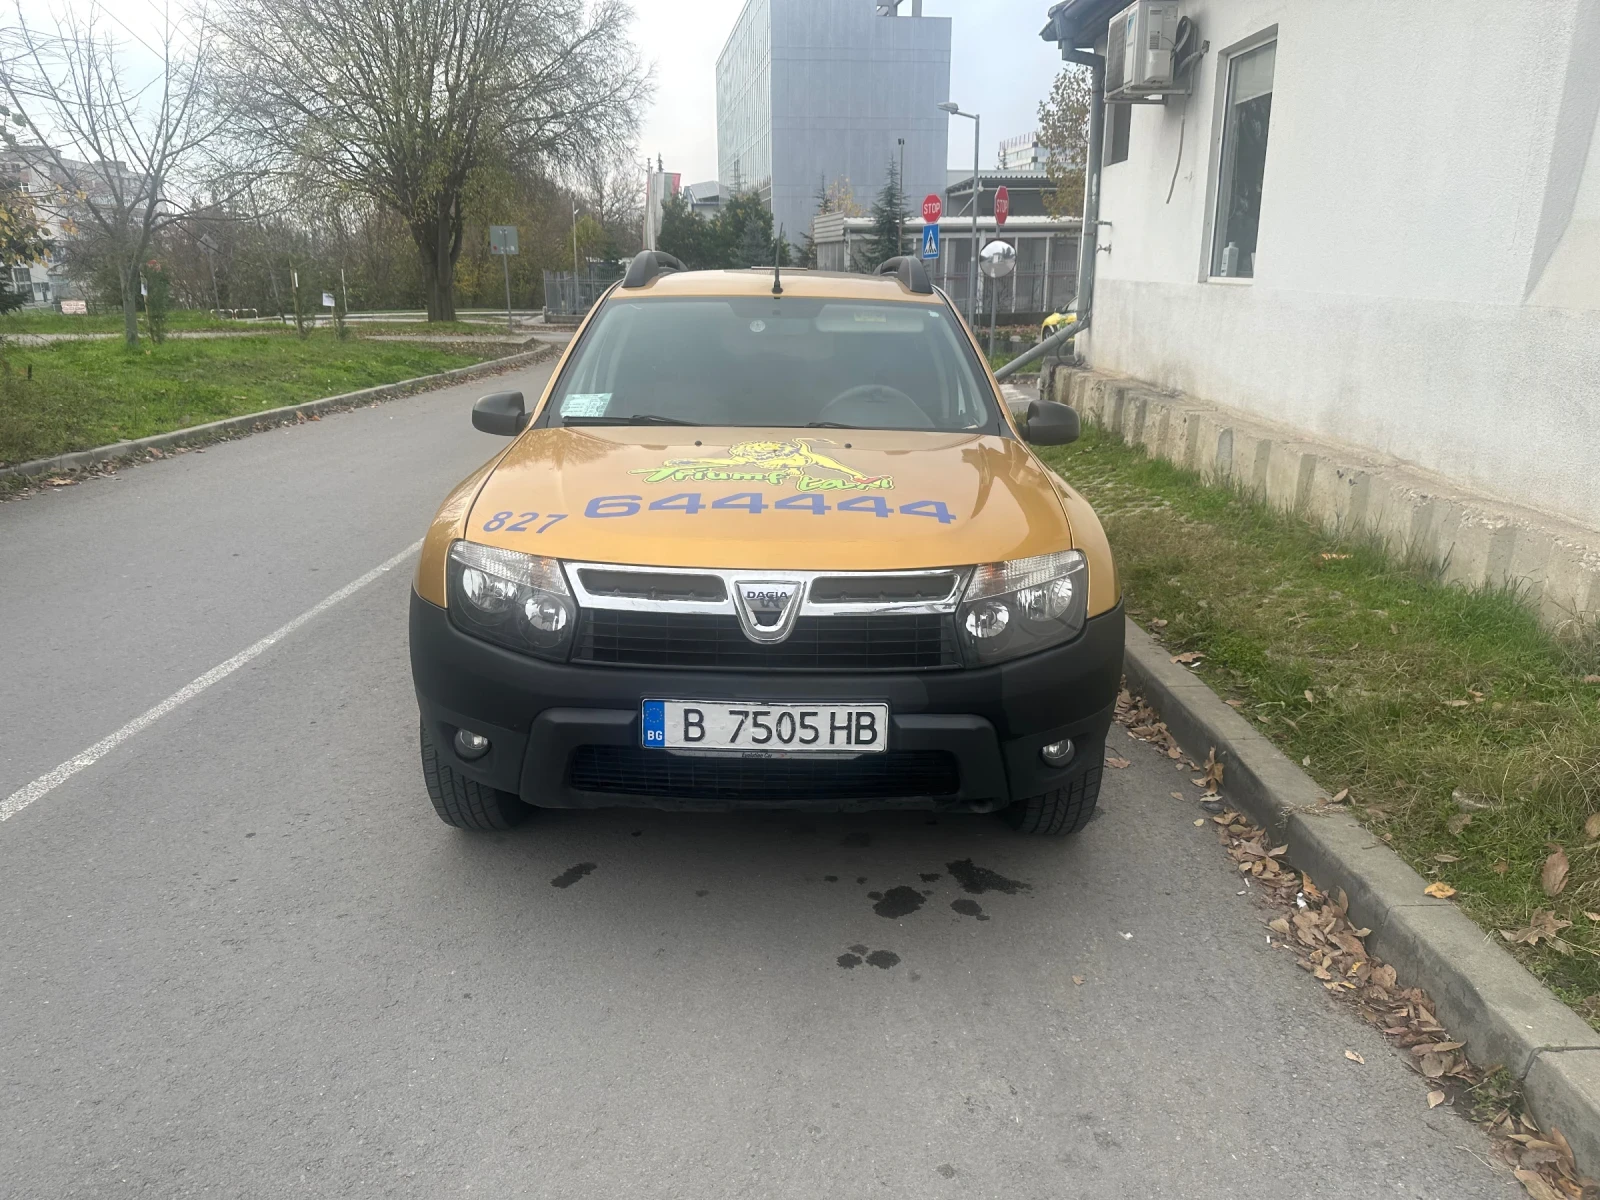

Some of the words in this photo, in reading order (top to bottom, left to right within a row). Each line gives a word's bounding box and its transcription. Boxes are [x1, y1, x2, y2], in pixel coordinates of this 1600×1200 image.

[923, 203, 940, 215] STOP
[996, 199, 1008, 213] STOP
[629, 463, 788, 484] Triumf
[483, 511, 568, 534] 827
[584, 492, 957, 525] 644444
[747, 591, 788, 599] DACIA
[683, 708, 706, 742] B
[647, 730, 663, 741] BG
